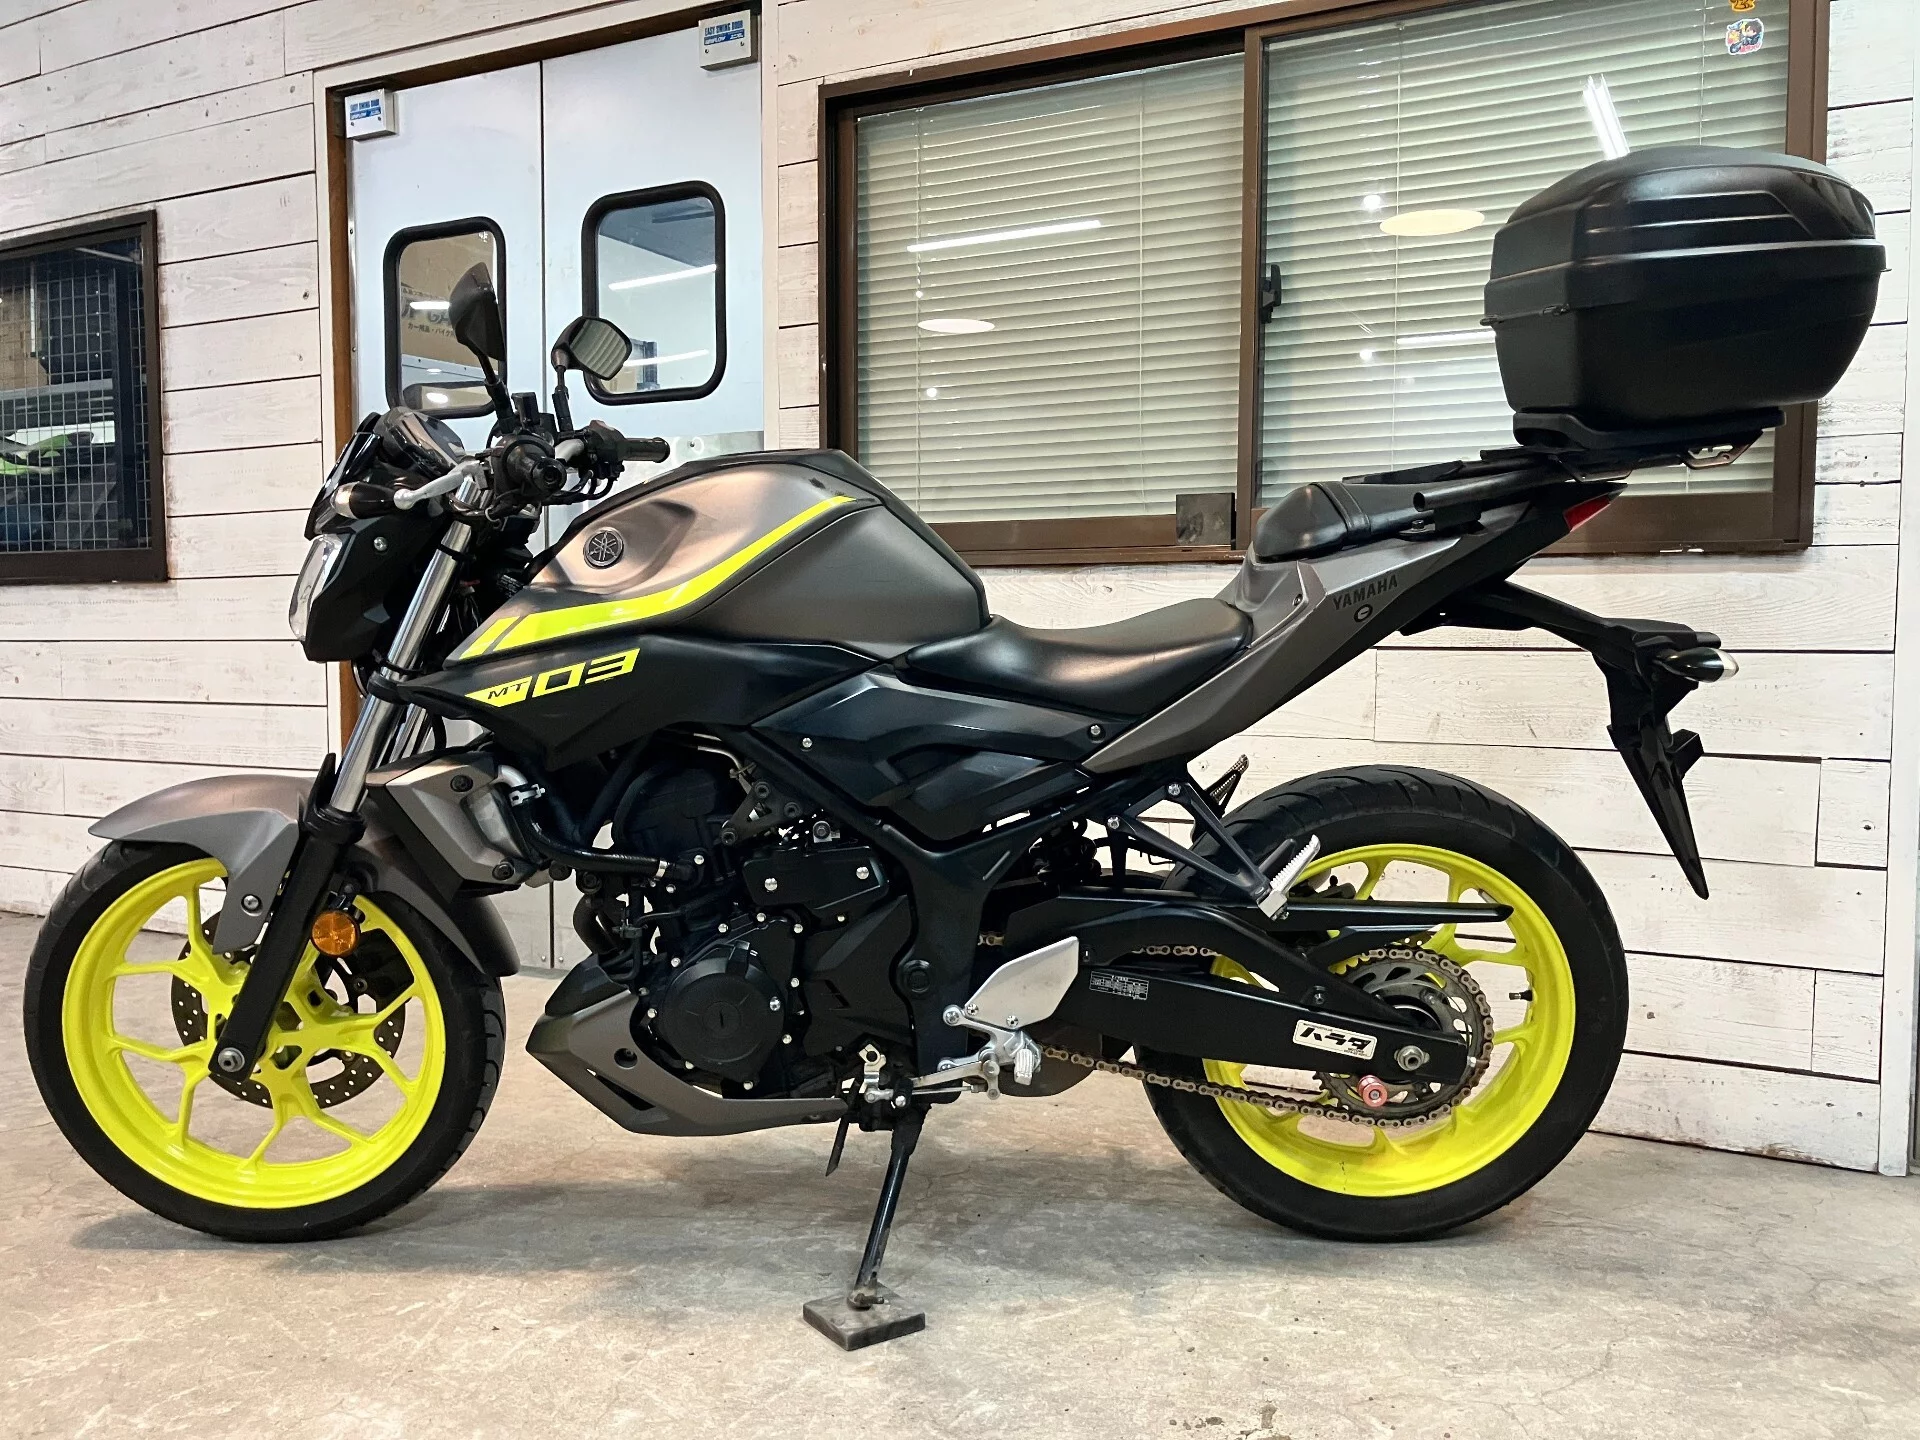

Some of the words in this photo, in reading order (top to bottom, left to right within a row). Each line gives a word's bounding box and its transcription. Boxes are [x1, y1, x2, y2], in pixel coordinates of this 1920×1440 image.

[1332, 574, 1398, 610] YAMAHA
[1300, 1026, 1372, 1050] ハラダ
